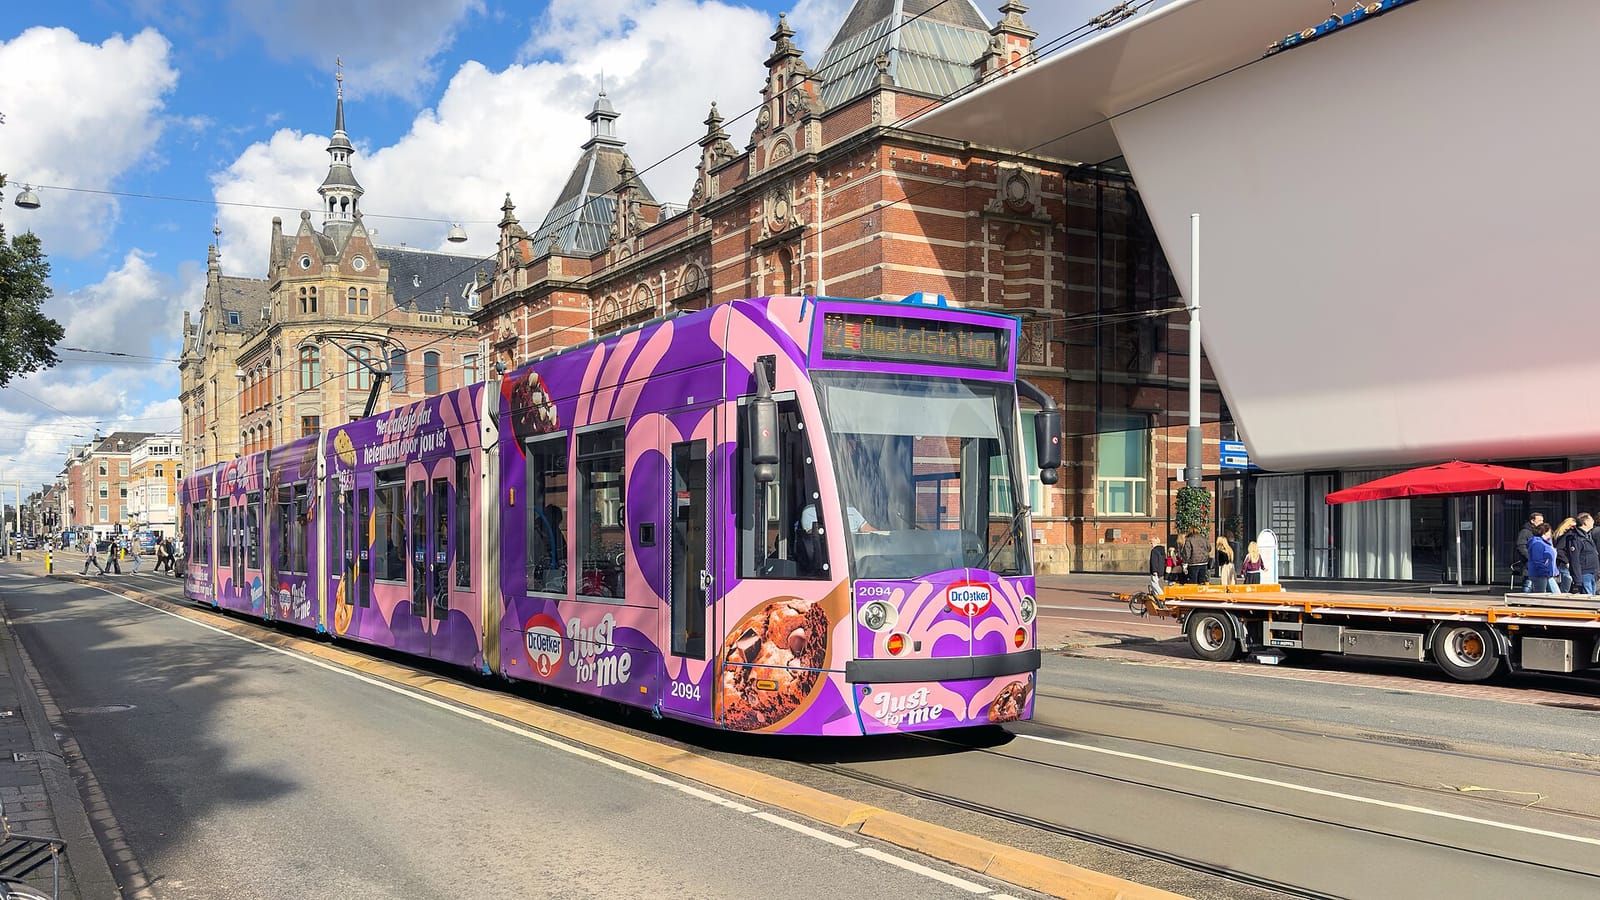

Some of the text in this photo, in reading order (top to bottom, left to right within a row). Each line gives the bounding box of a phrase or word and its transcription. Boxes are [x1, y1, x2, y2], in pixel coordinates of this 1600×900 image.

[862, 318, 997, 360] Amstelstation
[376, 406, 432, 437] Het cakeje dat
[364, 425, 447, 465] helemaal voor jou is!
[859, 587, 892, 596] 2094
[566, 612, 617, 667] Just
[576, 652, 632, 688] for me
[671, 681, 701, 701] 2094
[873, 687, 931, 719] Just
[884, 703, 944, 727] for me
